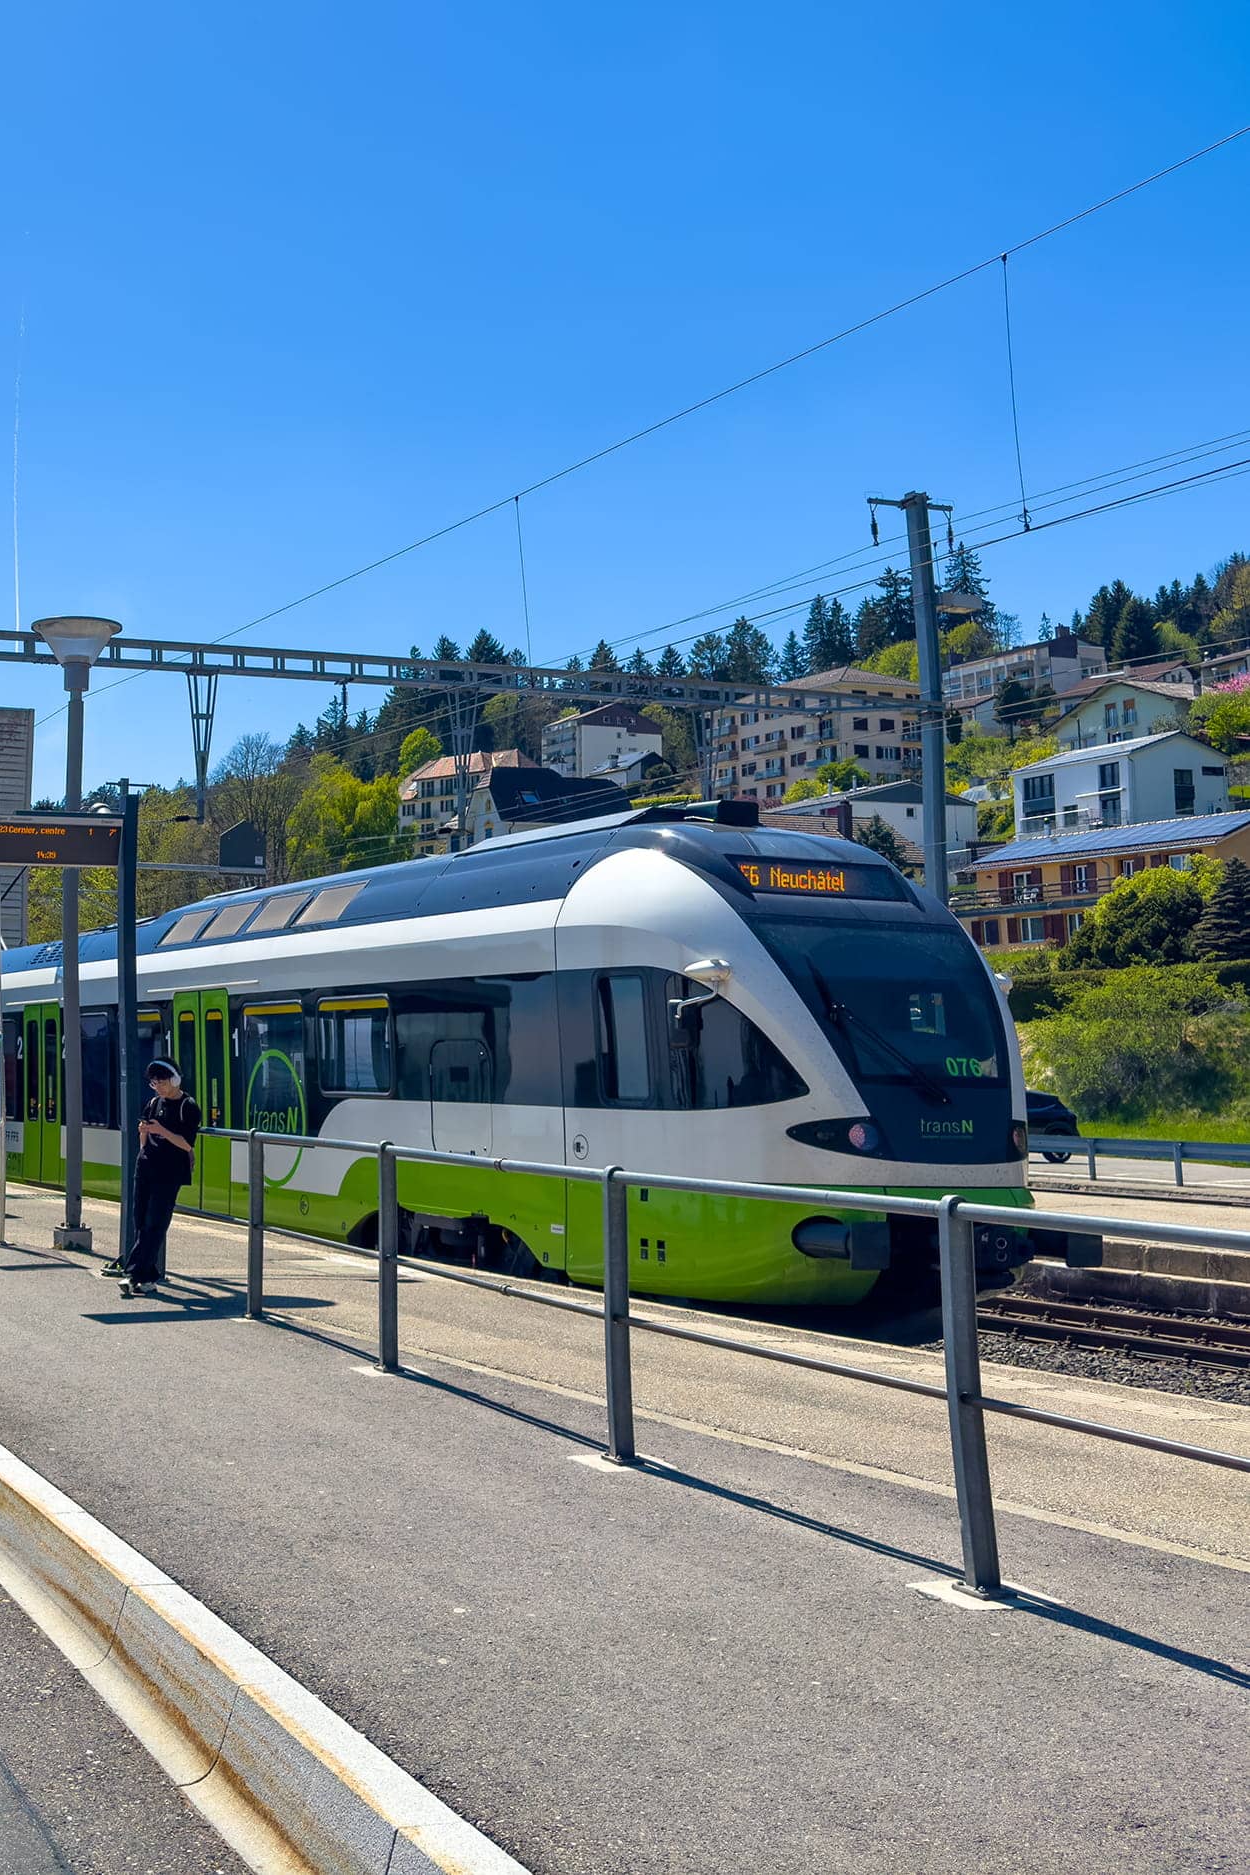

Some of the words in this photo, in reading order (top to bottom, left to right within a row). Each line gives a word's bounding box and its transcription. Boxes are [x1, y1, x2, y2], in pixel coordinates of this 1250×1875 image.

[8, 825, 39, 835] Cernier,
[40, 827, 66, 835] centre
[88, 828, 93, 836] 1
[36, 850, 57, 859] 14:39
[770, 867, 846, 892] Neuchâtel
[17, 1036, 23, 1059] 2
[232, 1028, 239, 1057] 1
[946, 1057, 983, 1077] 076
[252, 1104, 299, 1133] transN
[920, 1118, 974, 1134] transN
